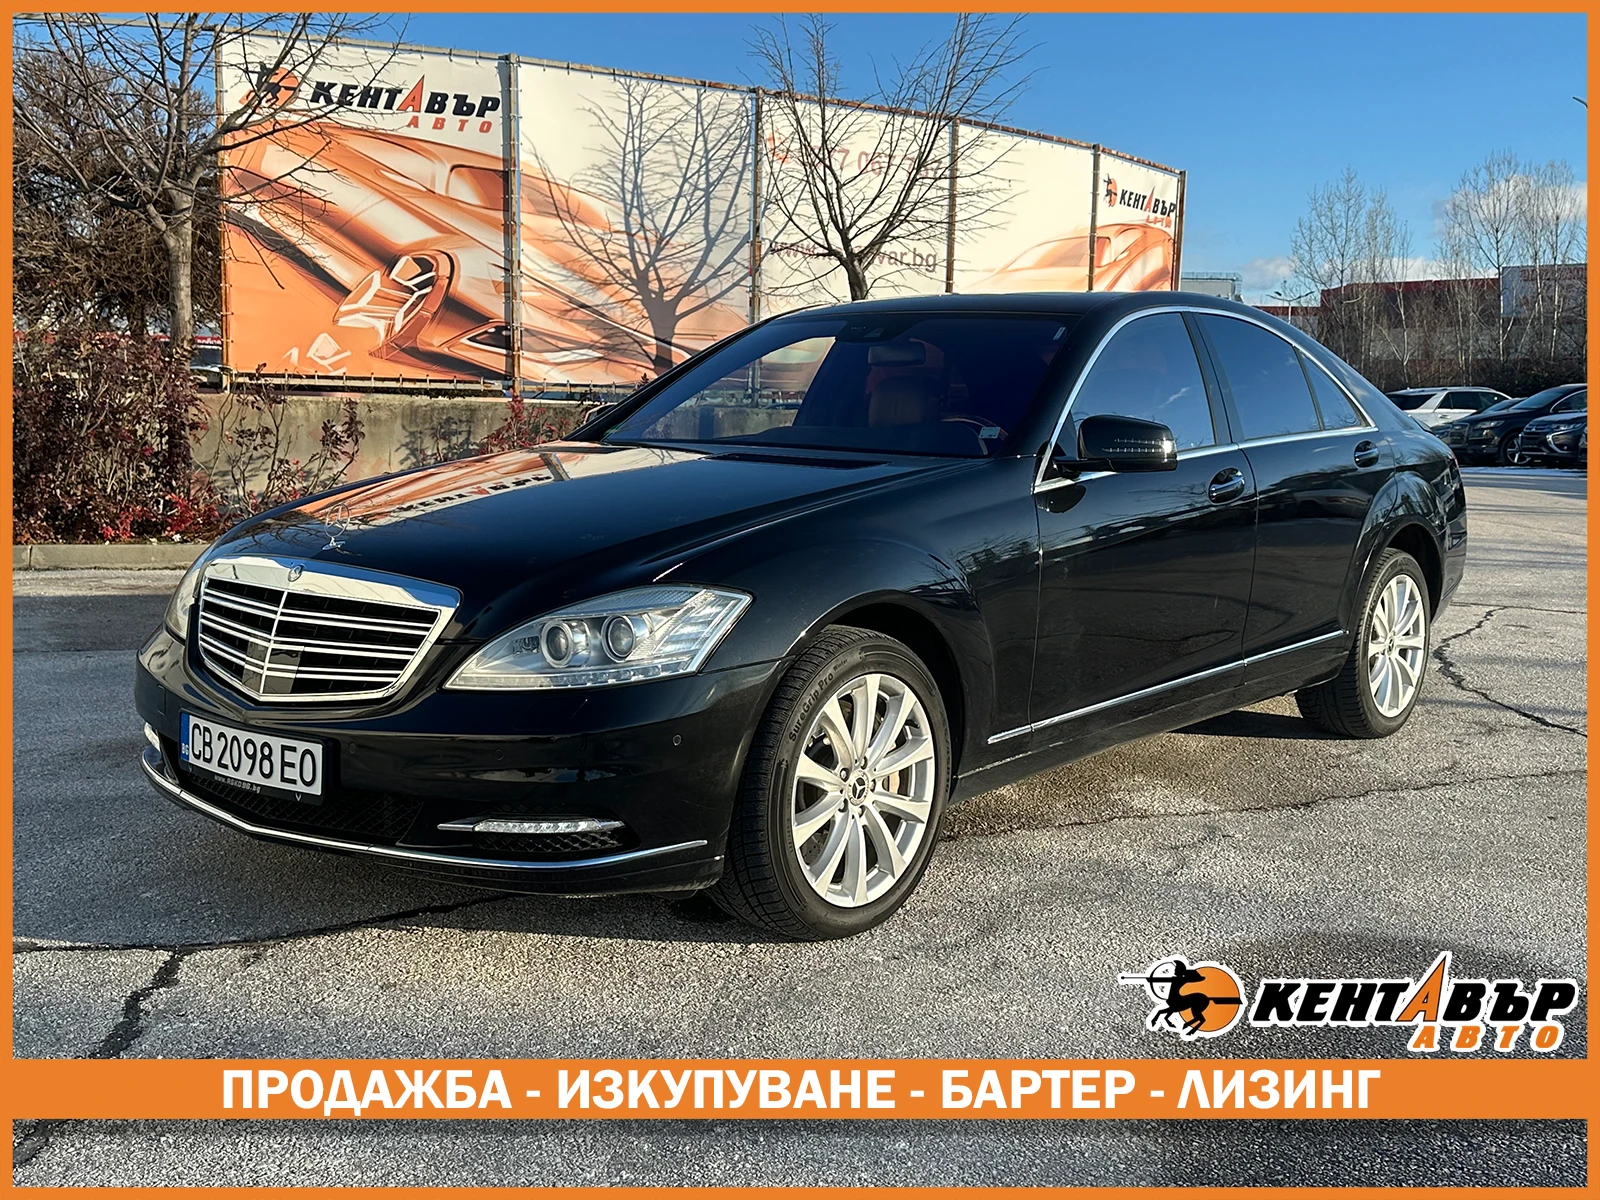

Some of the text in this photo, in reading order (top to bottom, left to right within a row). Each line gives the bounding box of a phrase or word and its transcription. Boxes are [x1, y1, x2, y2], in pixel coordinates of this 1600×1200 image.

[309, 74, 501, 118] КЕНТАВЪР
[406, 116, 493, 134] АВТО
[1119, 186, 1177, 217] КЕНТАВЪР
[788, 690, 820, 742] SureGrip
[817, 672, 835, 691] Pro
